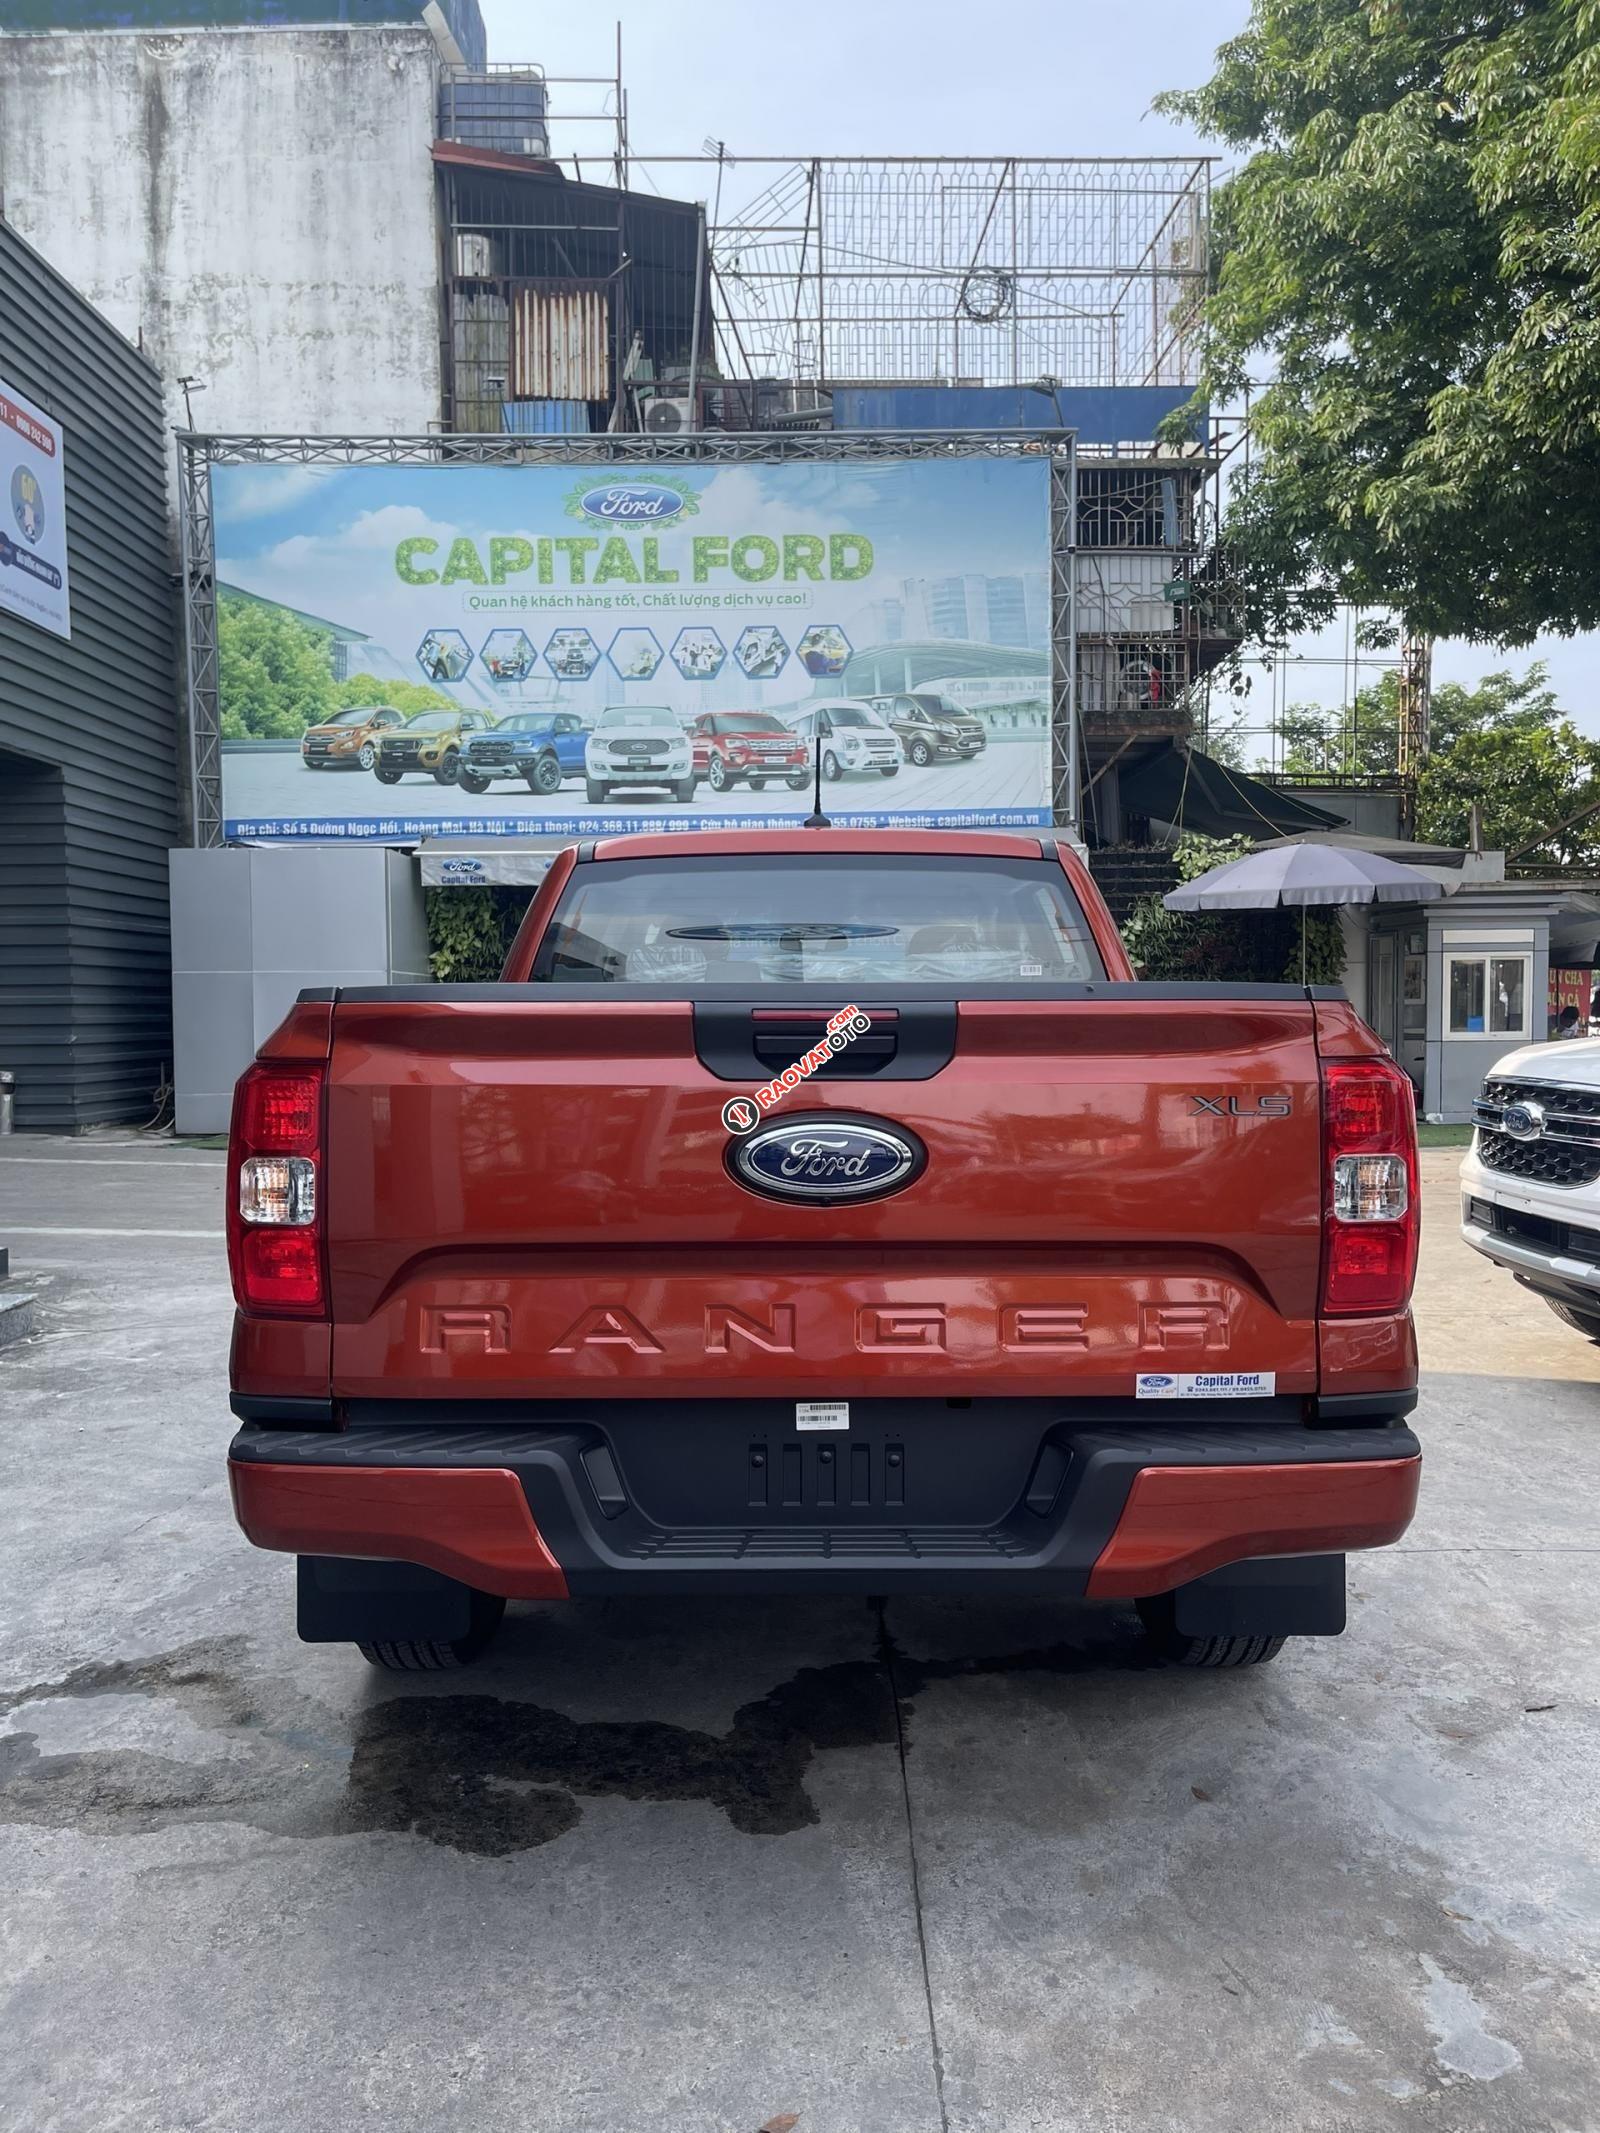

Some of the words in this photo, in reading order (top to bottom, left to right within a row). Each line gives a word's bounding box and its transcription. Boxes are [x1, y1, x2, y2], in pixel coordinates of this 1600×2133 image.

[600, 488, 664, 515] Ford
[395, 536, 680, 586] CAPITAL
[692, 534, 874, 583] FORD
[469, 596, 507, 610] Quan
[510, 595, 528, 610] hệ
[531, 595, 573, 608] khách
[576, 594, 612, 608] hàng
[616, 593, 640, 608] tốt,
[643, 593, 676, 606] Chất
[680, 593, 720, 608] lượng
[724, 593, 753, 607] dịch
[756, 594, 773, 607] vụ
[777, 593, 806, 604] cao!
[237, 824, 256, 836] Địa
[282, 821, 298, 834] Số
[300, 824, 307, 834] 5
[310, 822, 345, 836] Đường
[348, 822, 376, 836] Ngọc
[404, 820, 438, 834] Hoàng
[442, 822, 466, 834] Mai,
[469, 820, 484, 833] Hà
[487, 820, 506, 834] Nội
[517, 820, 542, 834] Điện
[545, 821, 576, 835] thoại:
[888, 815, 934, 828] Website:
[938, 814, 1039, 827] capitalford.com.vn
[1188, 1096, 1292, 1116] XLS
[780, 1139, 871, 1176] Ford
[419, 1302, 1230, 1354] RANGER
[1195, 1375, 1234, 1387] Capital
[1237, 1374, 1260, 1386] Ford
